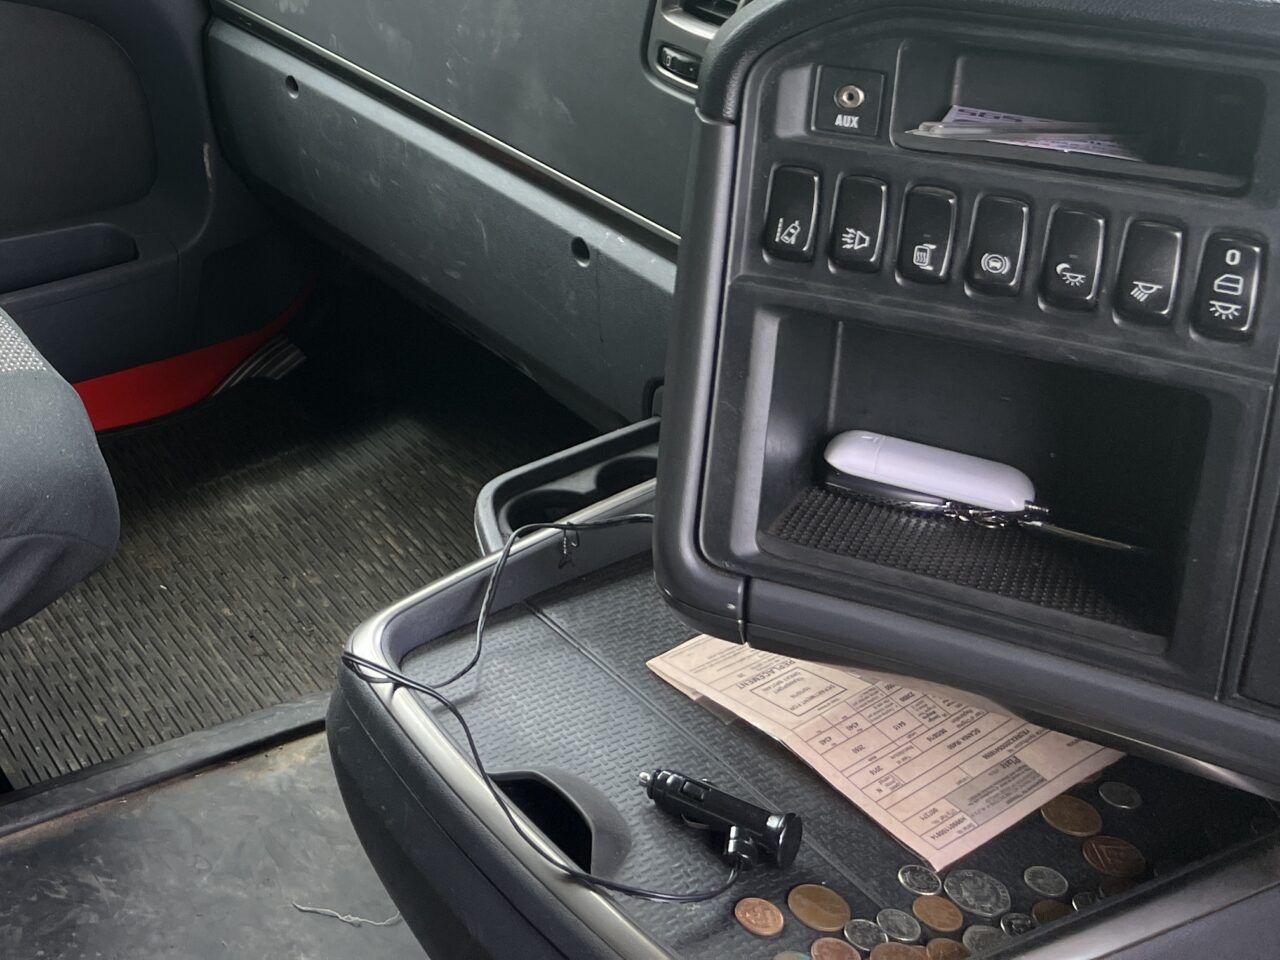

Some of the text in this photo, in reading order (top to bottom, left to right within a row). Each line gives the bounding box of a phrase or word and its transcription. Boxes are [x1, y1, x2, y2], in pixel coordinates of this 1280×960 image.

[834, 114, 859, 129] AUX
[735, 658, 796, 691] REPLACEMENT
[960, 728, 981, 741] SCANIA
[1000, 756, 1020, 769] Plate
